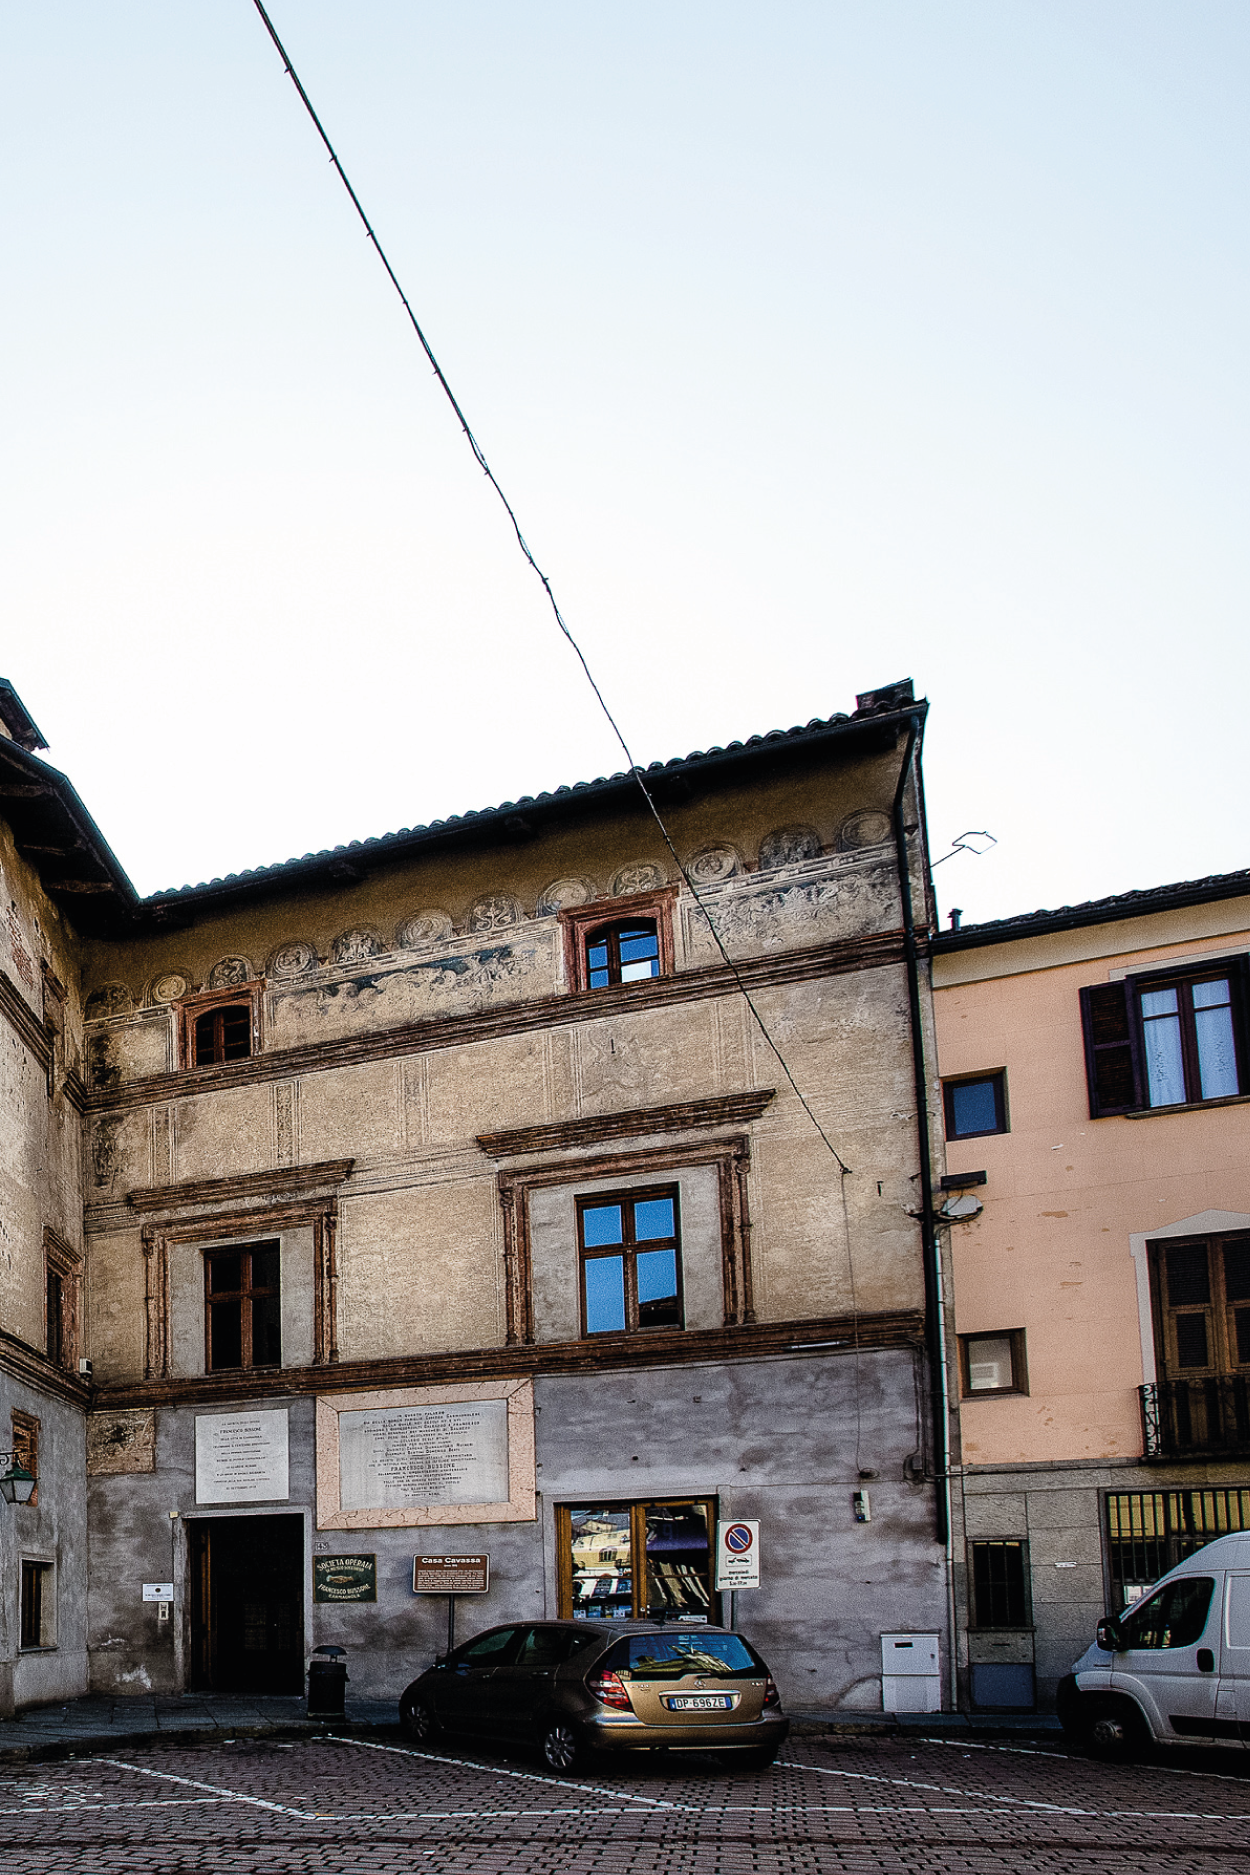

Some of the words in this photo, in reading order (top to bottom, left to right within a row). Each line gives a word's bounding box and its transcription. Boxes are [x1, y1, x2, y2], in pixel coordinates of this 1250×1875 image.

[345, 1559, 372, 1570] OPERAIA
[317, 1584, 347, 1594] FRANCESCO
[676, 1699, 688, 1708] DP
[692, 1697, 725, 1707] 696ZE
